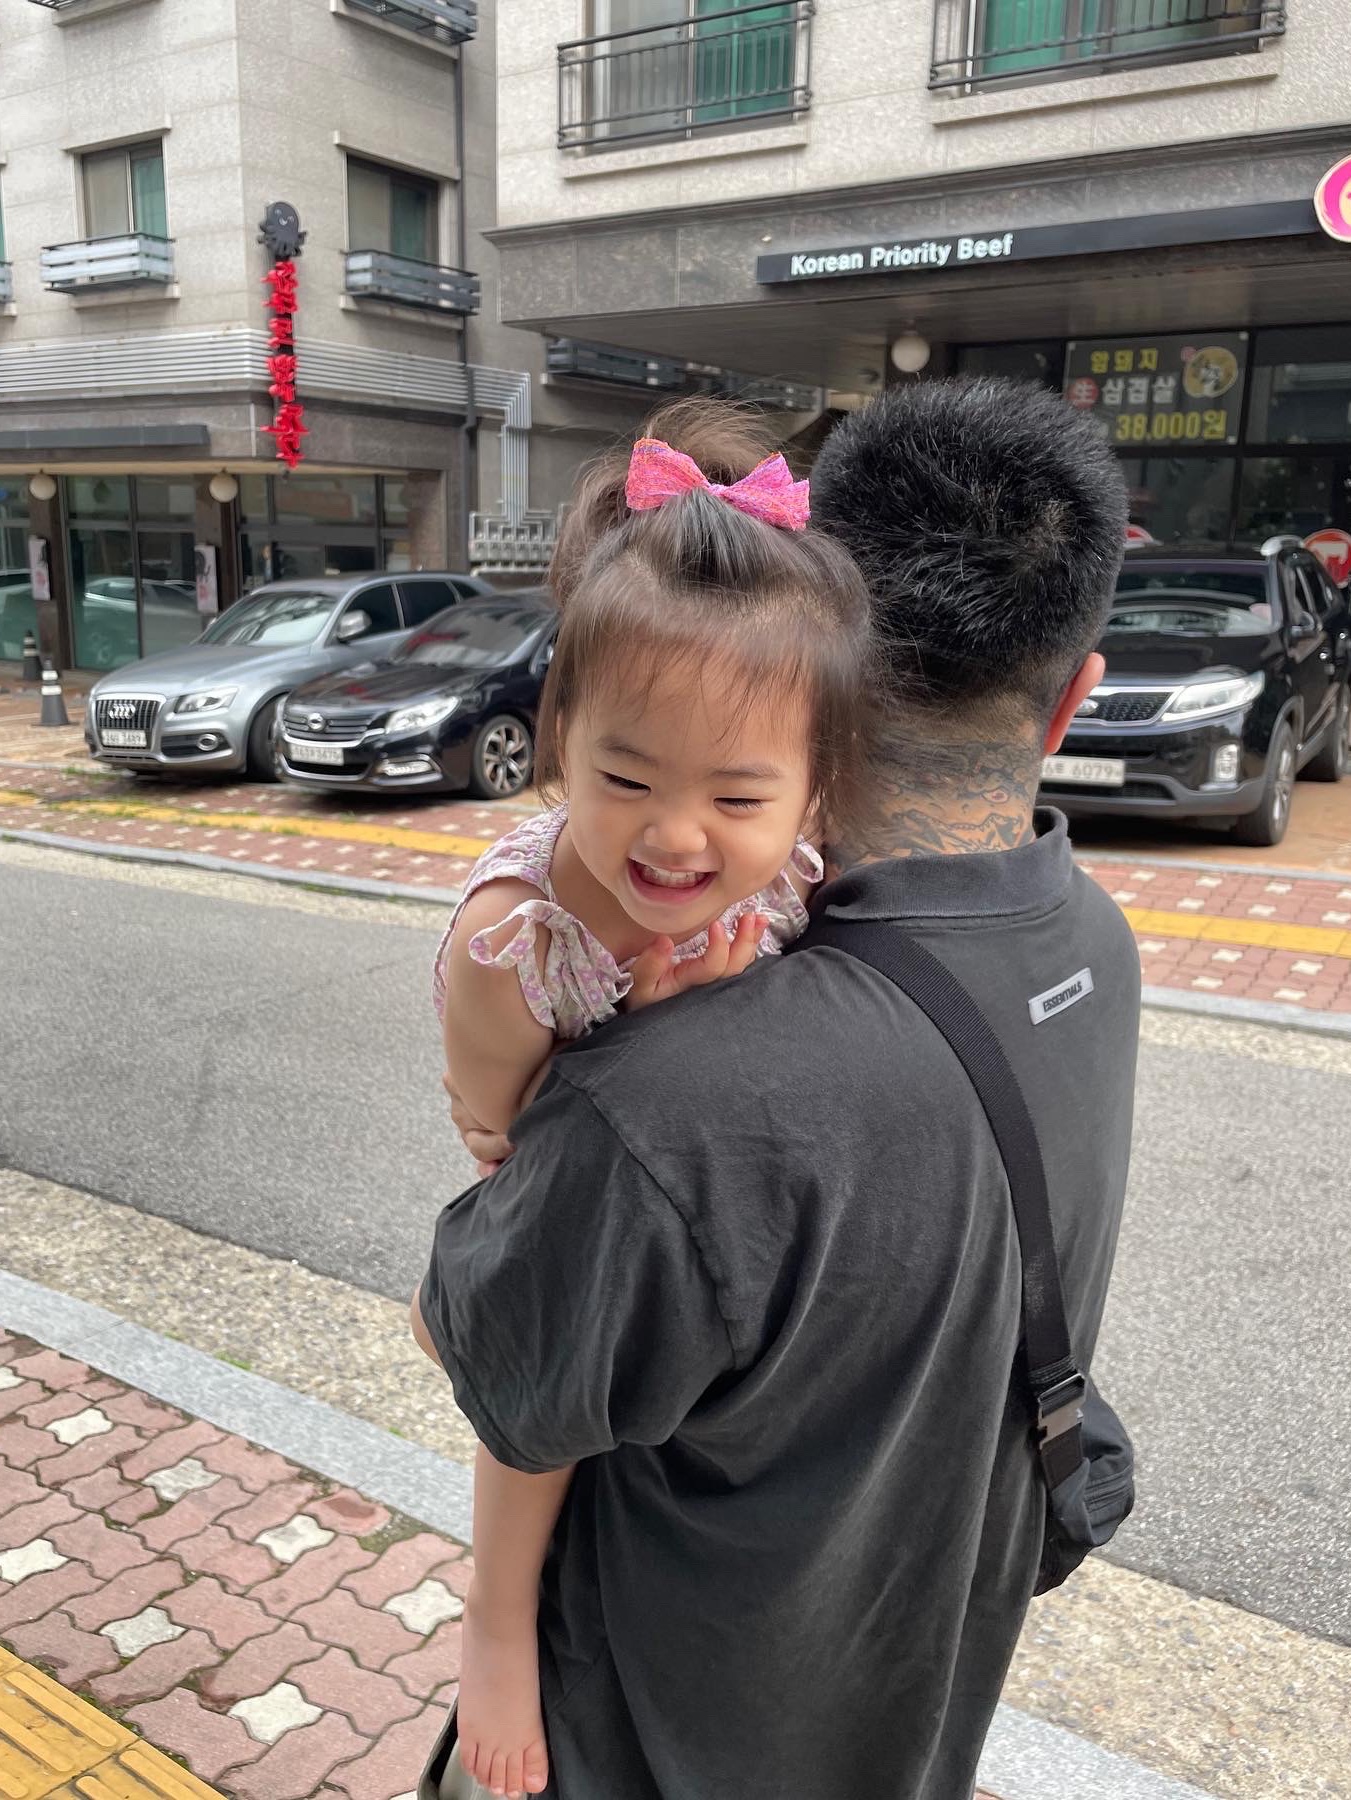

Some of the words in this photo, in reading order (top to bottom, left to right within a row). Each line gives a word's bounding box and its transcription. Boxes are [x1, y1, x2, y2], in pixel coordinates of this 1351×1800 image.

[790, 255, 864, 276] Korean
[870, 241, 952, 268] Priority
[957, 233, 1014, 260] Beef
[1043, 981, 1083, 1013] ESSENTIALS
